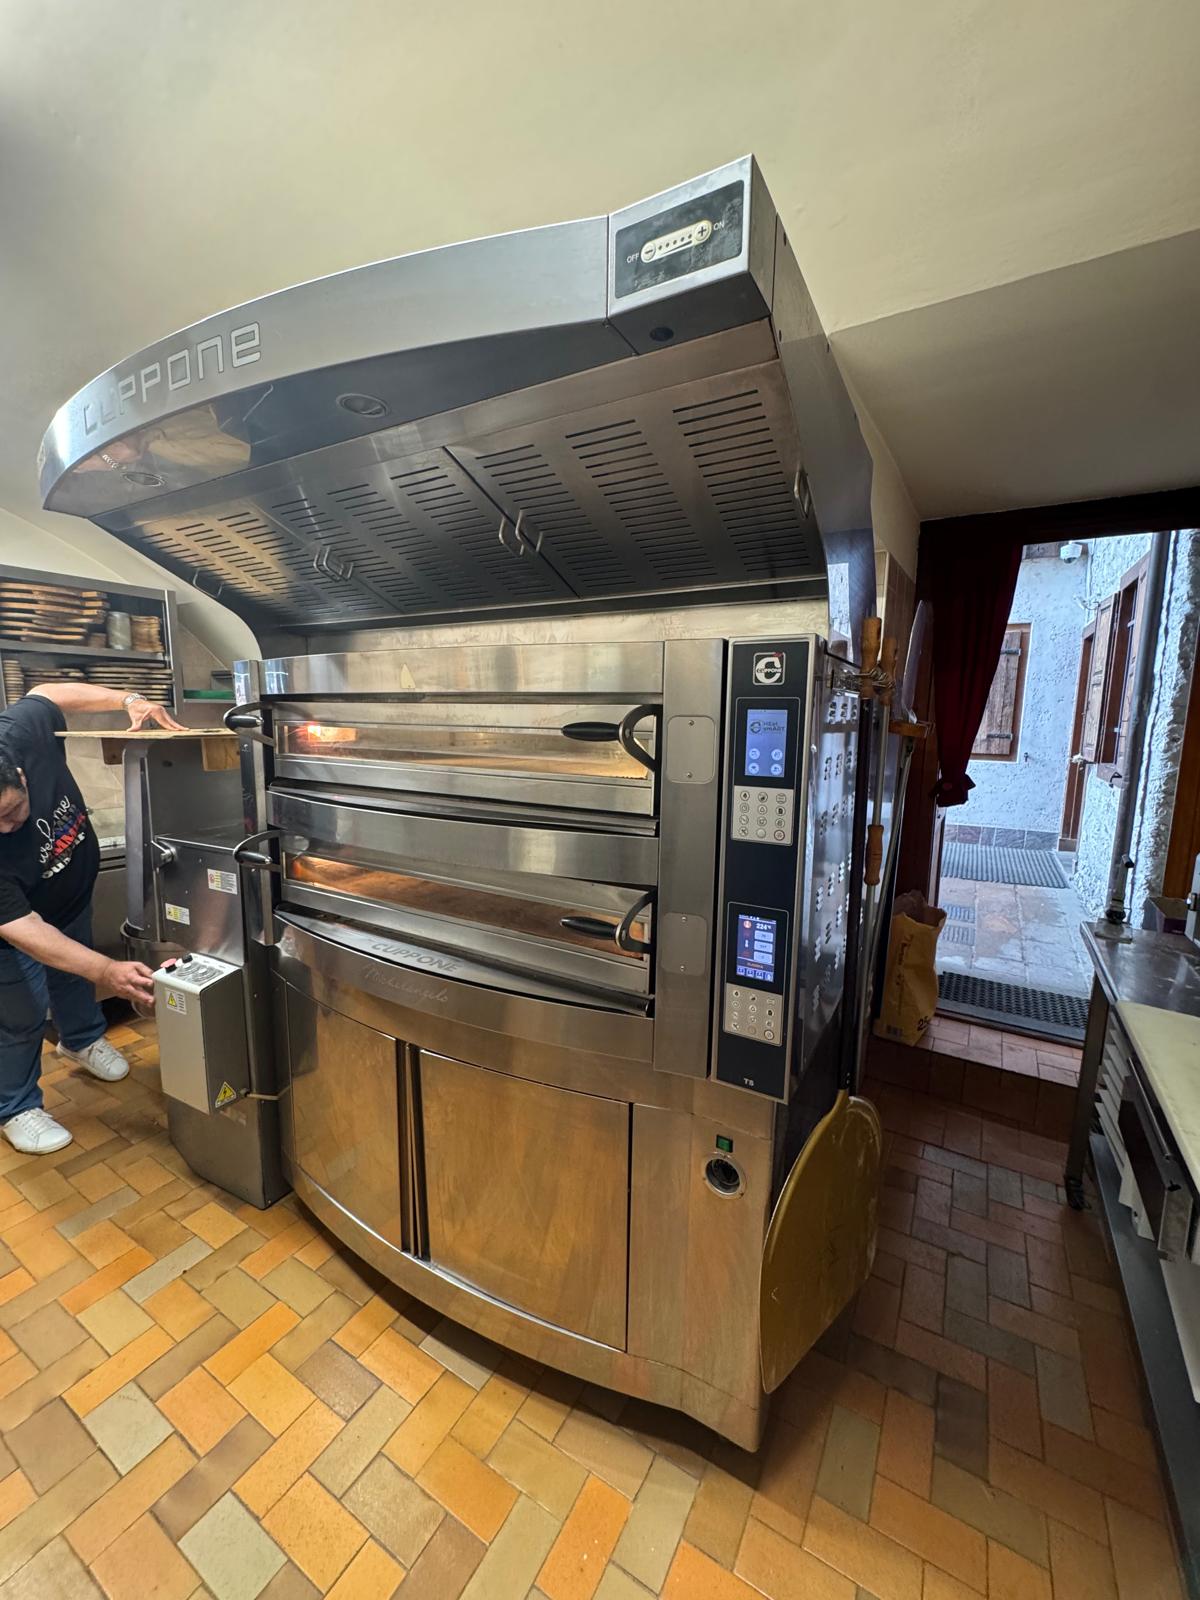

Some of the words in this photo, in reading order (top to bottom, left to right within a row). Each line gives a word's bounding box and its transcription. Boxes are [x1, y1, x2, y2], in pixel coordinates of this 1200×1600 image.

[713, 221, 724, 230] ON
[626, 252, 640, 264] OFF
[371, 942, 459, 973] CUPPONE
